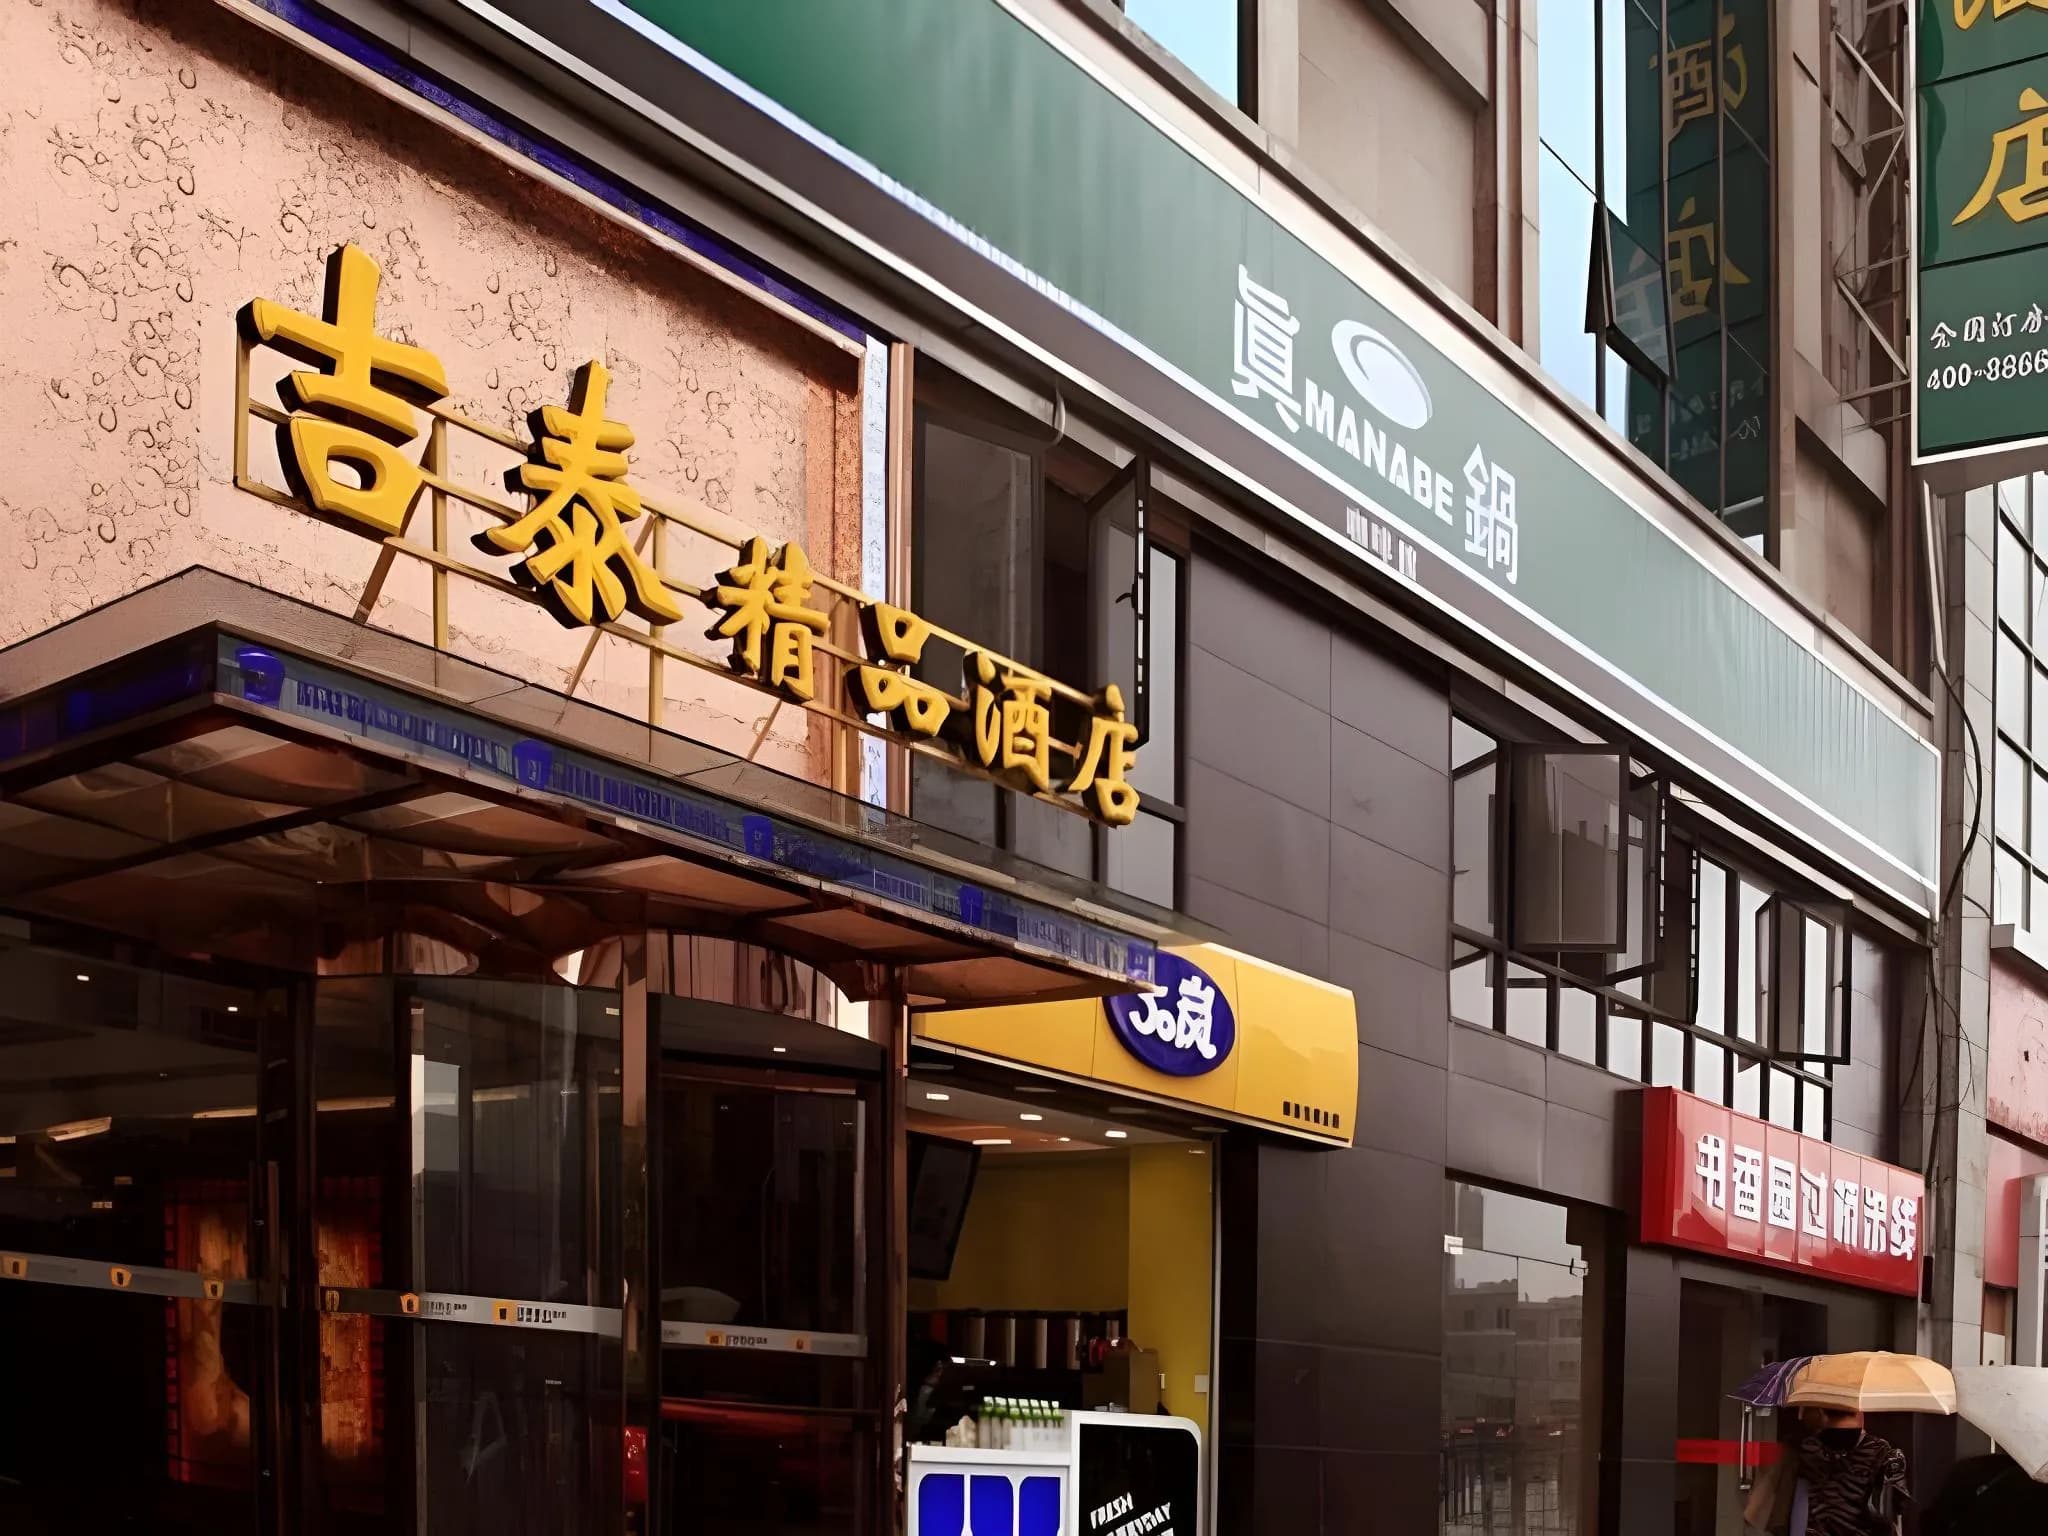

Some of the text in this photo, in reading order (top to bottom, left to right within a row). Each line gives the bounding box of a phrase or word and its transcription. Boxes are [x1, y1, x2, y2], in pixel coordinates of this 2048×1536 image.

[238, 243, 1140, 826] 吉泰精品酒店
[1305, 377, 1454, 526] MANABE
